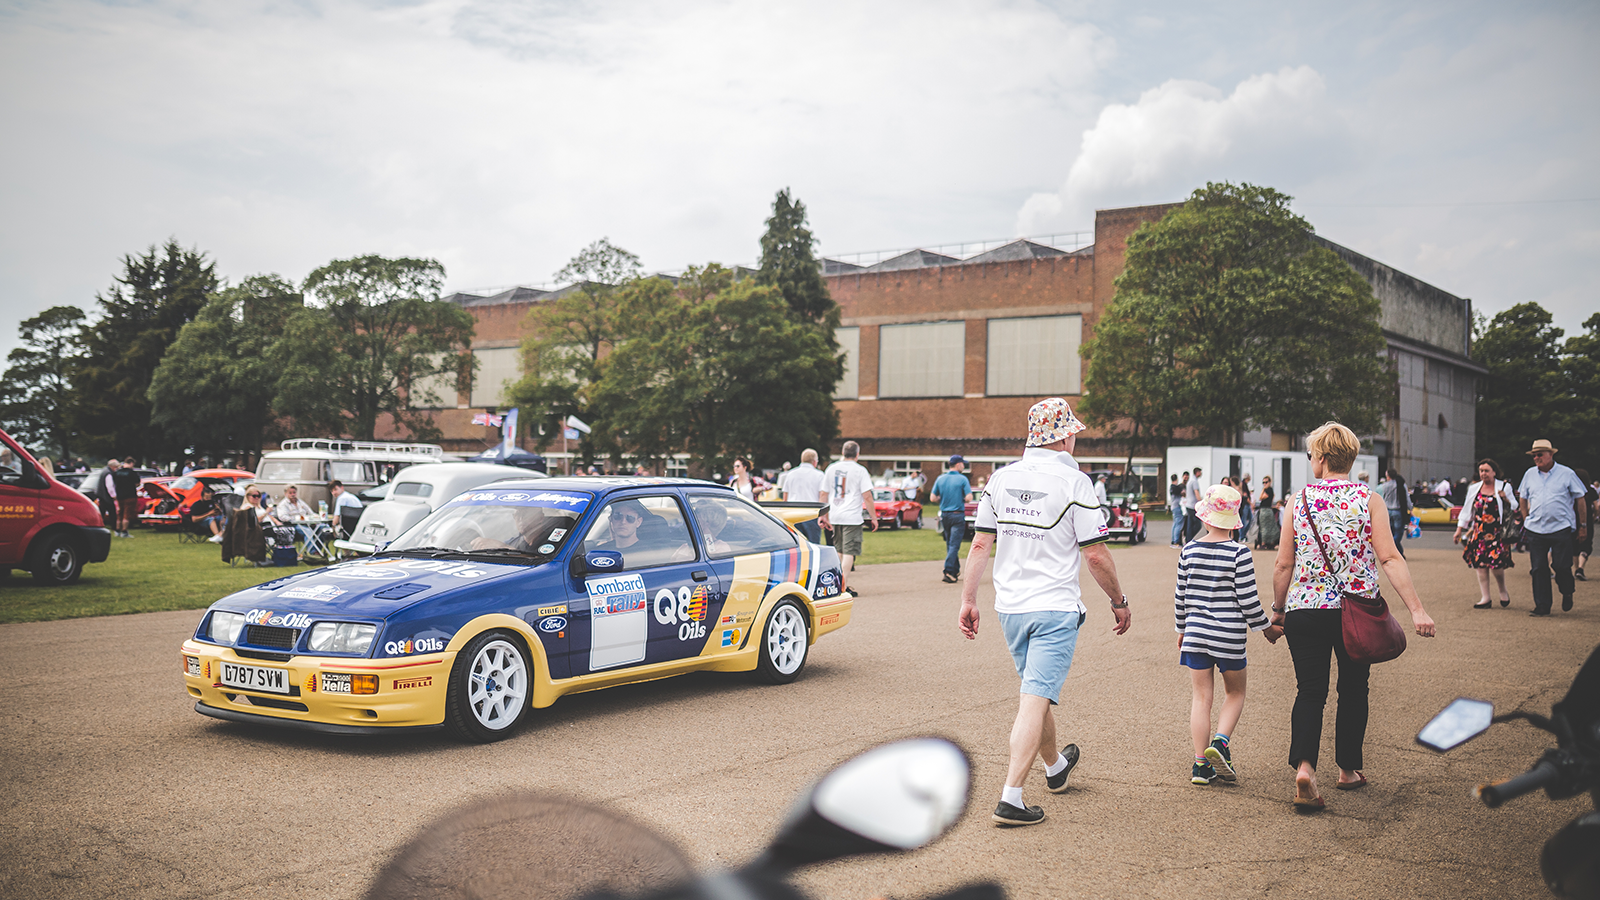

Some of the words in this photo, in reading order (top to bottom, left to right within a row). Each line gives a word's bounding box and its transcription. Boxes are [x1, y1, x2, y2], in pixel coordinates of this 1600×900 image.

[1005, 507, 1042, 517] BENTLEY
[586, 576, 643, 596] Lombard
[593, 606, 606, 615] RAC
[609, 592, 644, 613] rally
[653, 586, 692, 626] Q8
[245, 608, 266, 625] Q8
[282, 612, 313, 628] Oils
[544, 618, 562, 630] Ford
[678, 621, 707, 642] Oils
[384, 640, 406, 655] Q8
[415, 637, 444, 652] Oils
[224, 663, 254, 685] D787
[257, 667, 283, 689] SVW
[393, 676, 433, 690] PIRELLI
[321, 680, 351, 693] Hella
